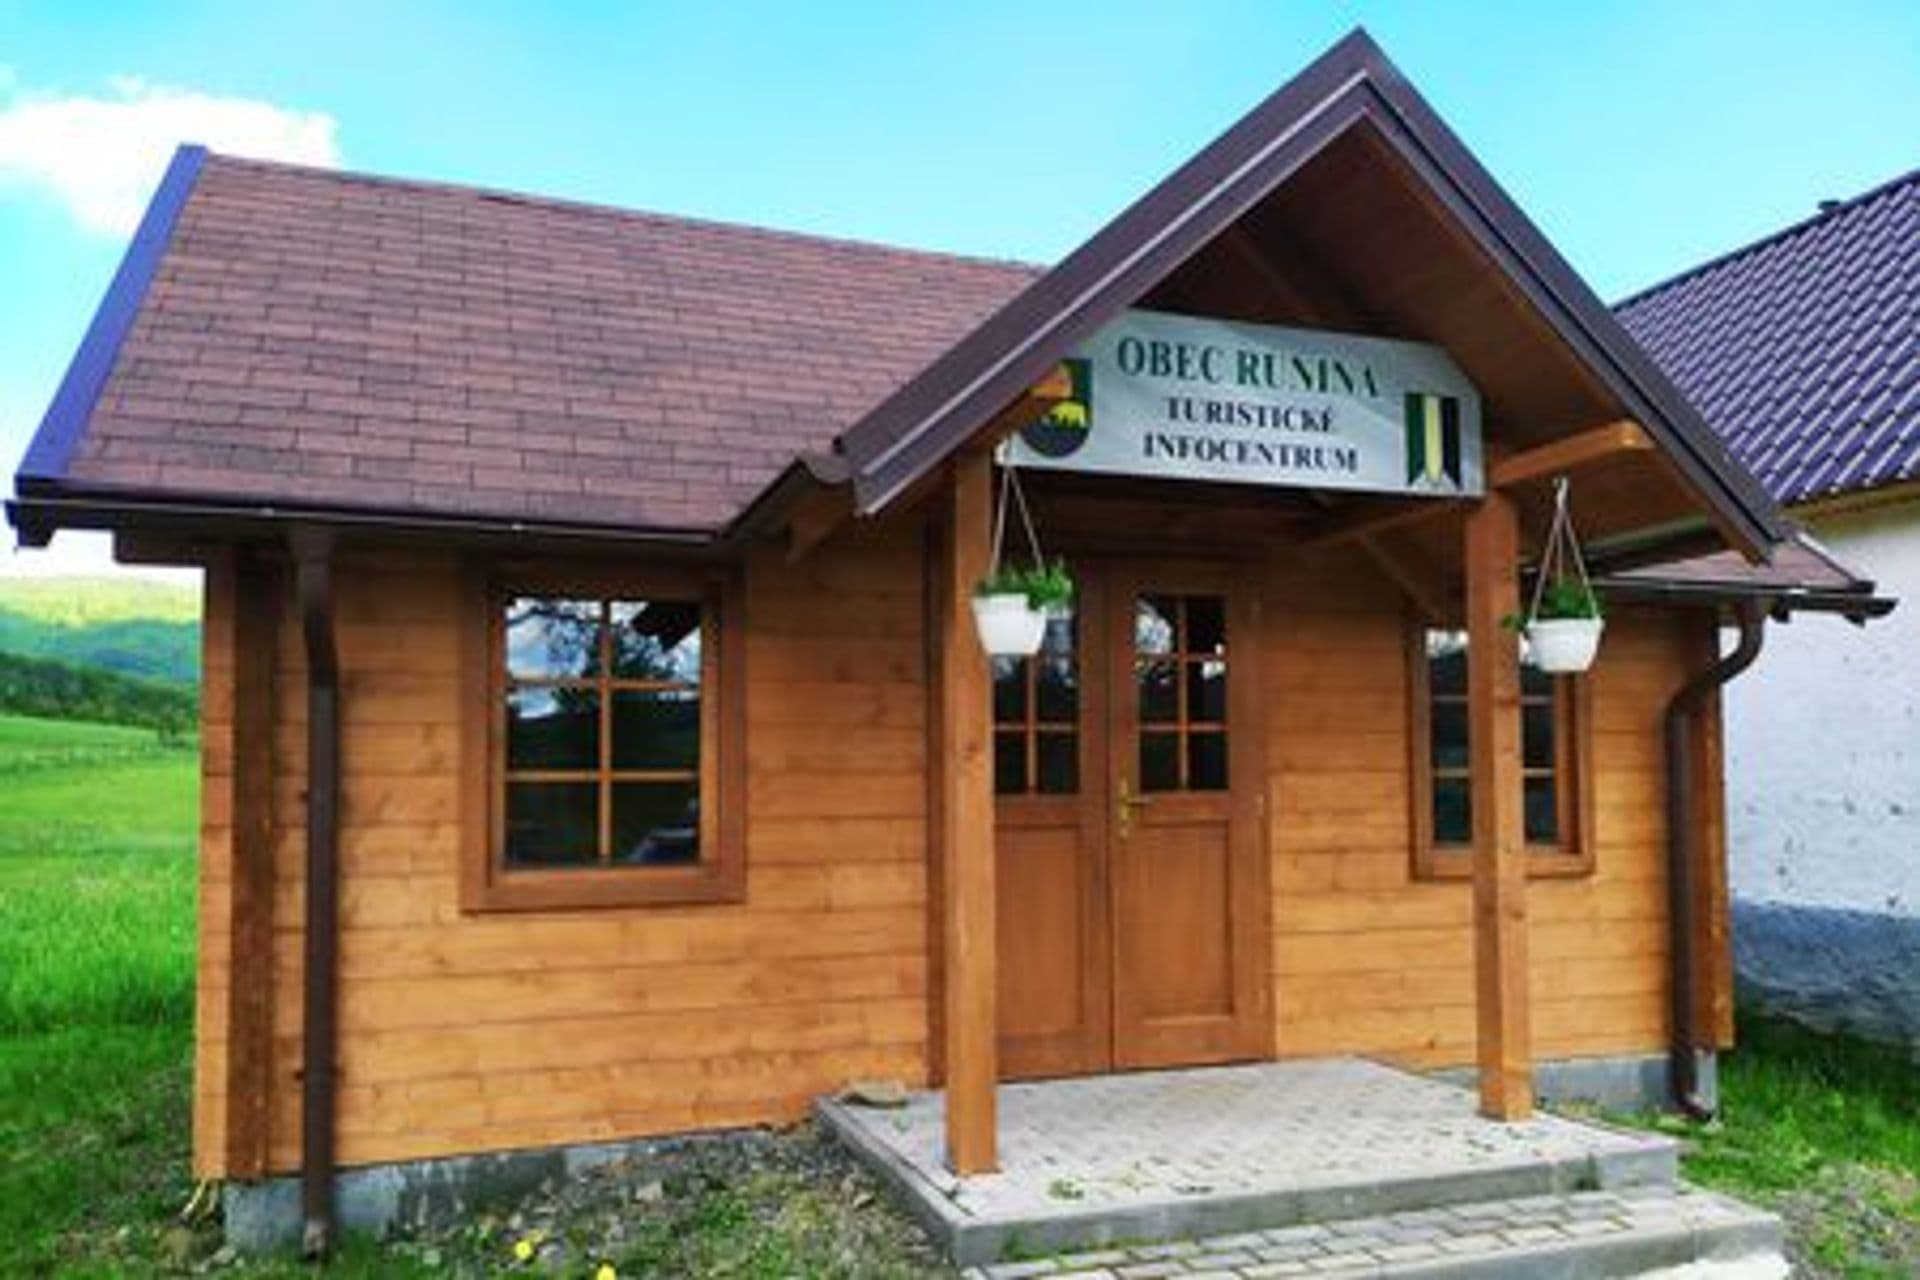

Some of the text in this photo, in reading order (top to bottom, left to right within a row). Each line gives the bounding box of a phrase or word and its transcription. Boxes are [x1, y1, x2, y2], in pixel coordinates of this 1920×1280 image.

[1116, 336, 1381, 398] OBEC RUNINA
[1166, 396, 1336, 433] TURISTICKÉ
[1142, 432, 1359, 473] INFOCENTRUM
